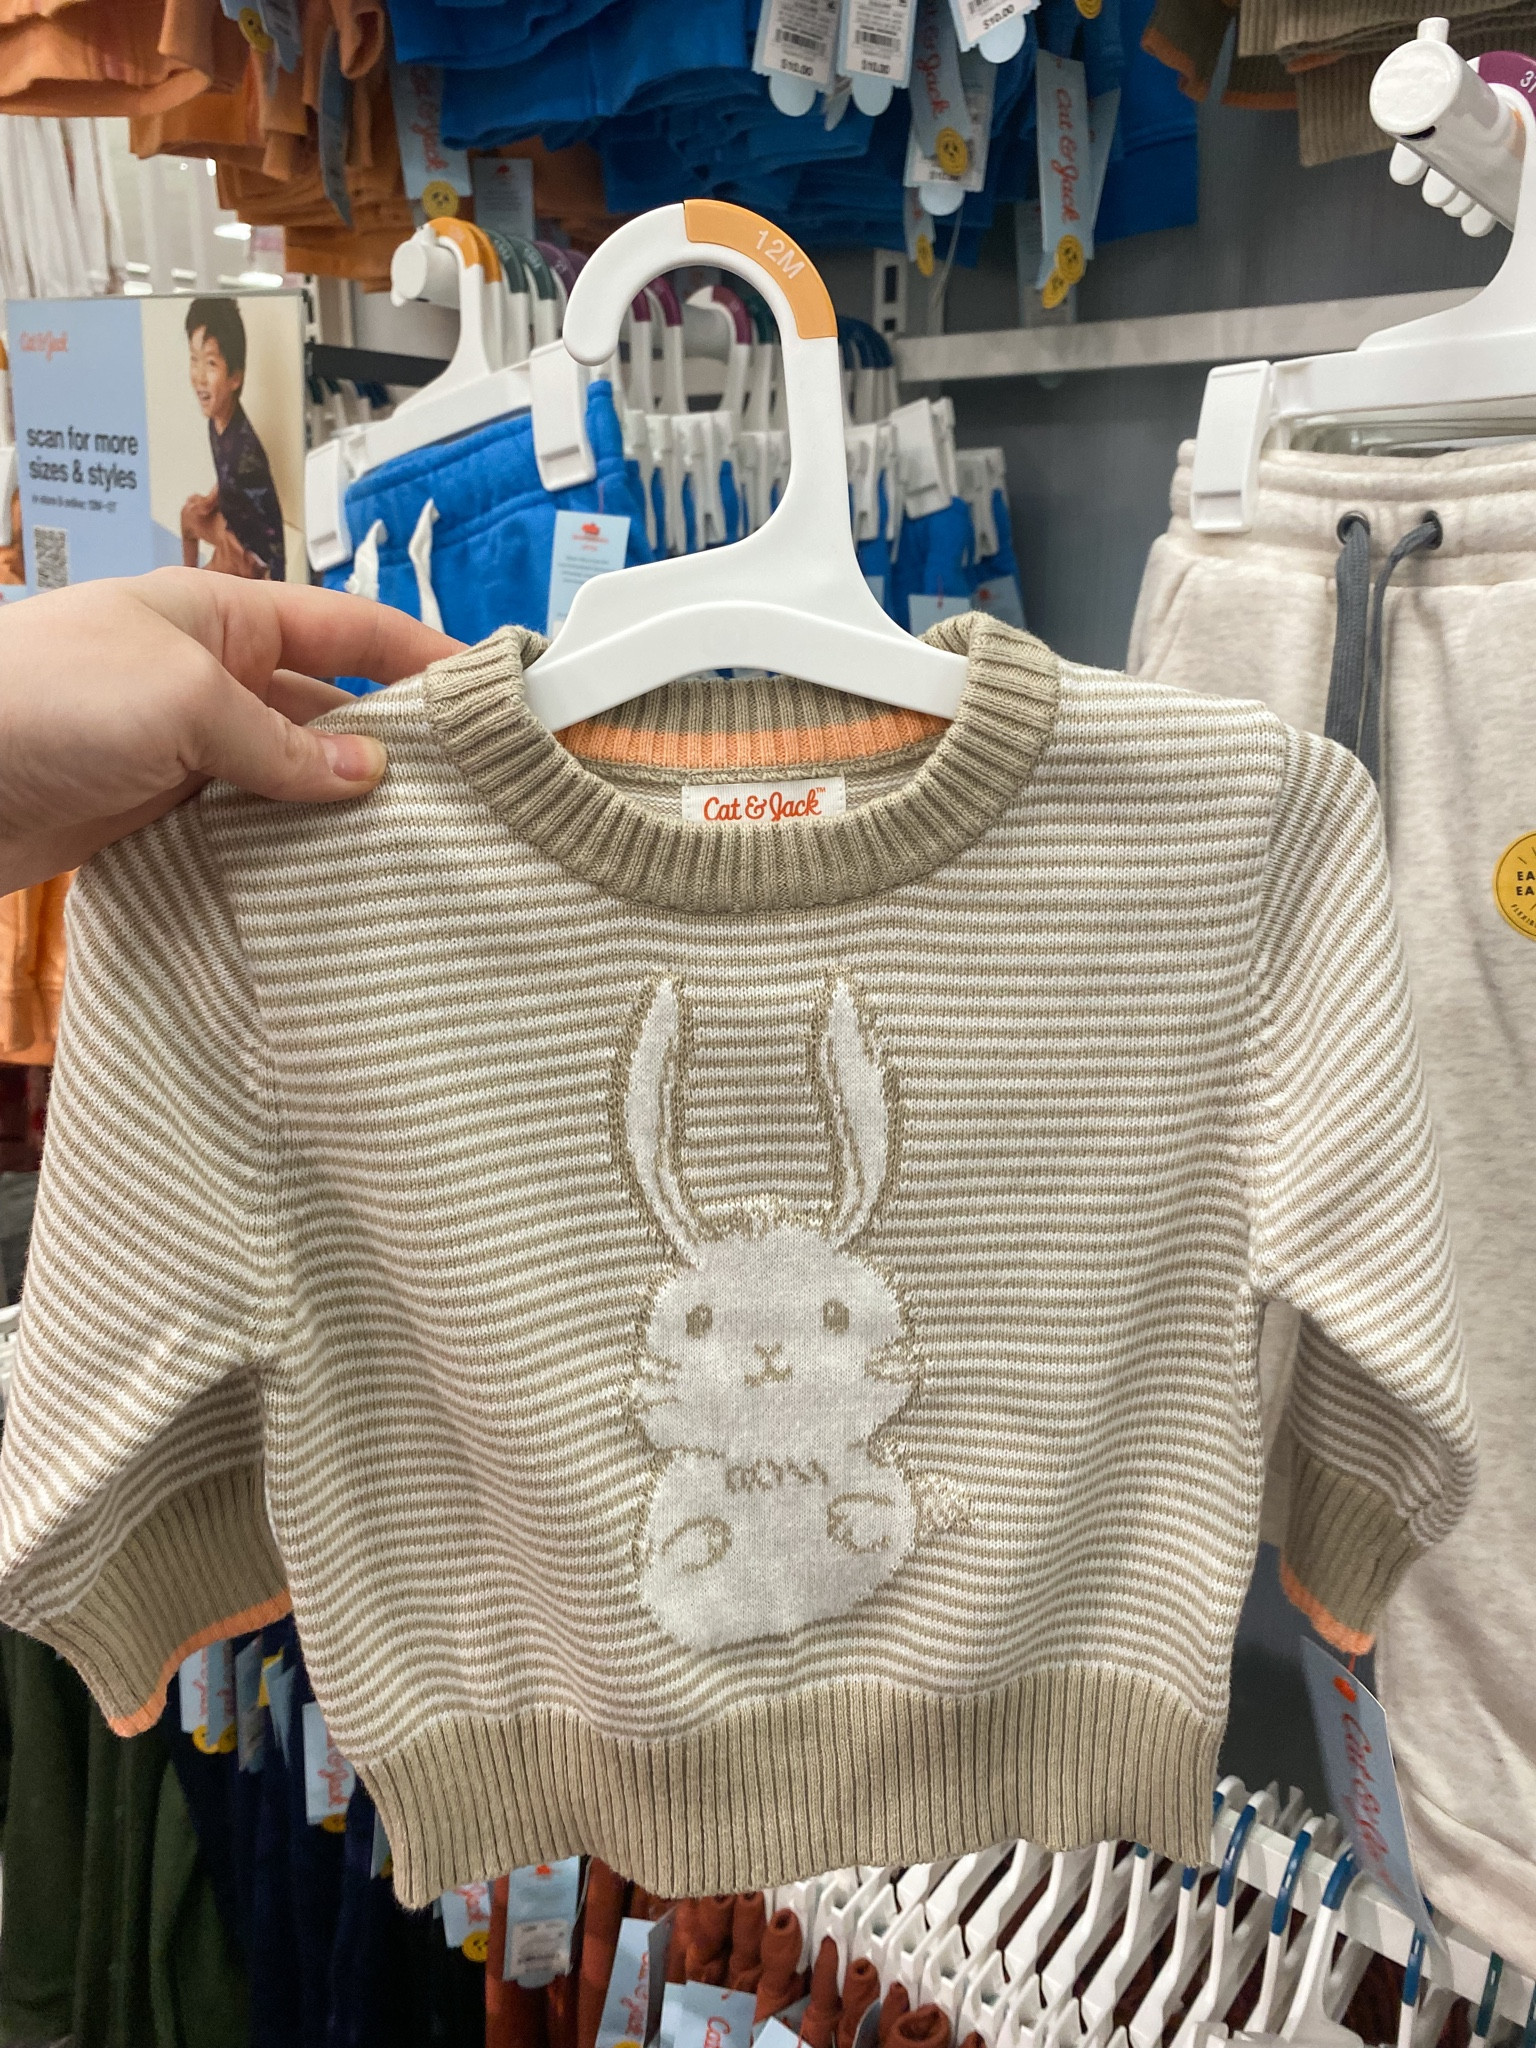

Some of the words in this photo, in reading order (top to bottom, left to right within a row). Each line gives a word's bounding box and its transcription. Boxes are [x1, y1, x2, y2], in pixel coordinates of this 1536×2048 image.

[983, 4, 1015, 30] $10.00
[1051, 159, 1080, 225] Jack
[756, 230, 805, 279] 12M
[27, 428, 64, 449] scan
[68, 425, 90, 450] for
[95, 433, 138, 456] more
[29, 456, 68, 482] sizes
[72, 459, 83, 484] &
[88, 462, 137, 493] styles
[703, 796, 742, 821] Cat
[745, 795, 767, 820] &
